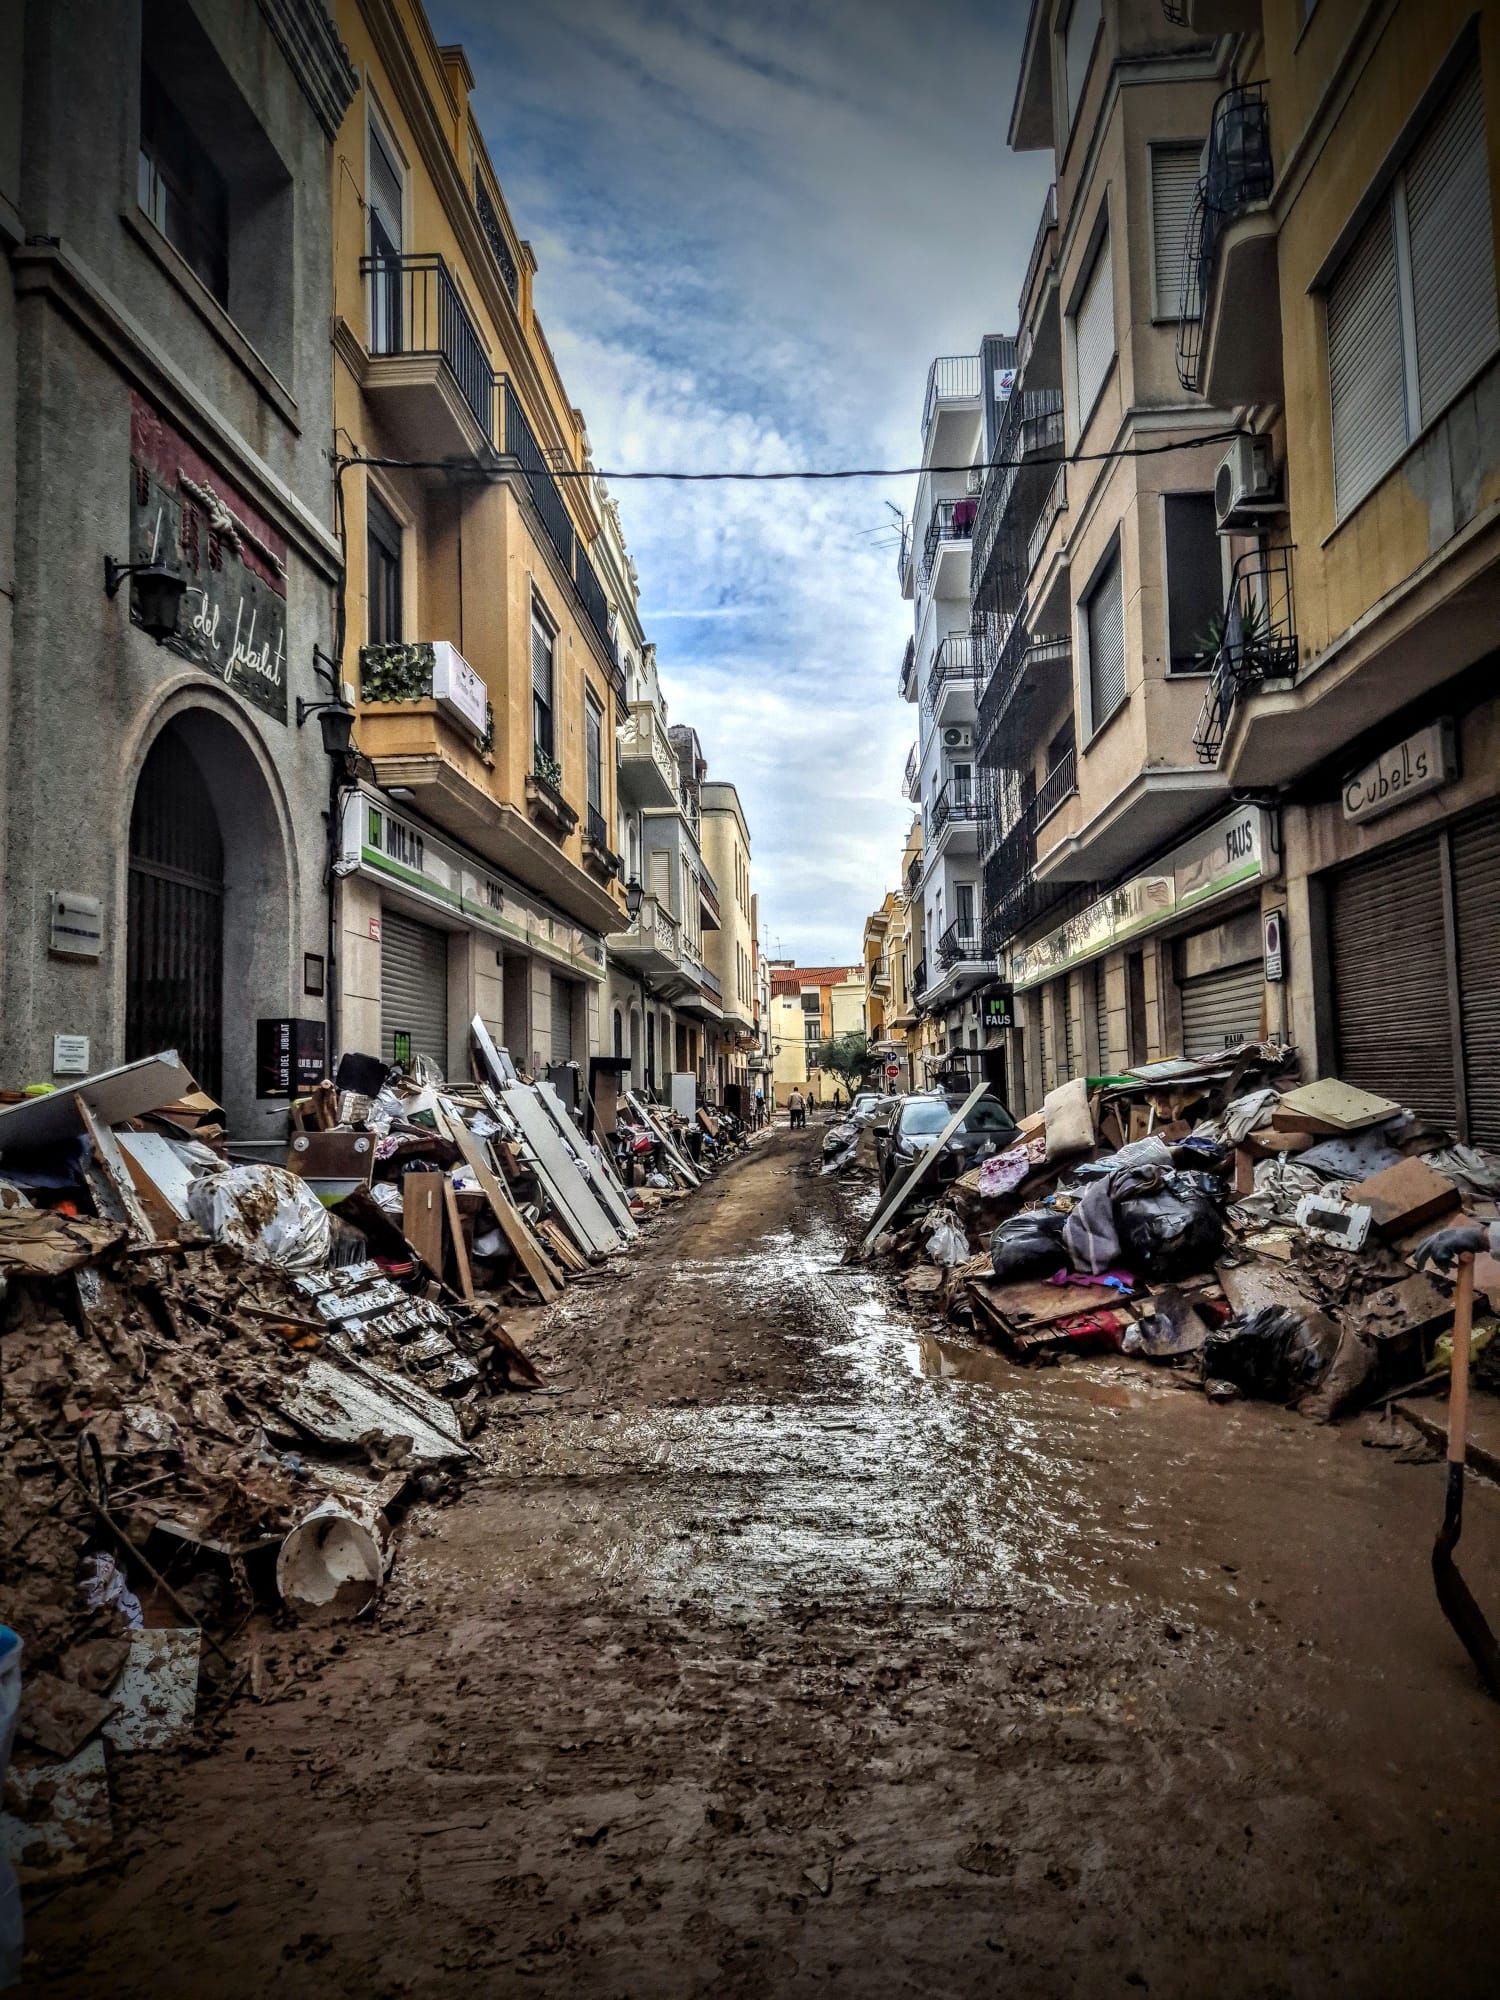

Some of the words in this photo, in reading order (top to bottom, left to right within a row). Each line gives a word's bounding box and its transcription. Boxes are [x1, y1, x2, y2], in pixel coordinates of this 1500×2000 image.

[193, 589, 220, 651] del
[386, 816, 425, 873] MILAR
[1226, 820, 1252, 863] FAUS
[985, 1014, 1011, 1026] FAUS
[281, 1024, 289, 1050] JUBILAT
[281, 1054, 289, 1067] DEL
[281, 1068, 289, 1086] LLAR
